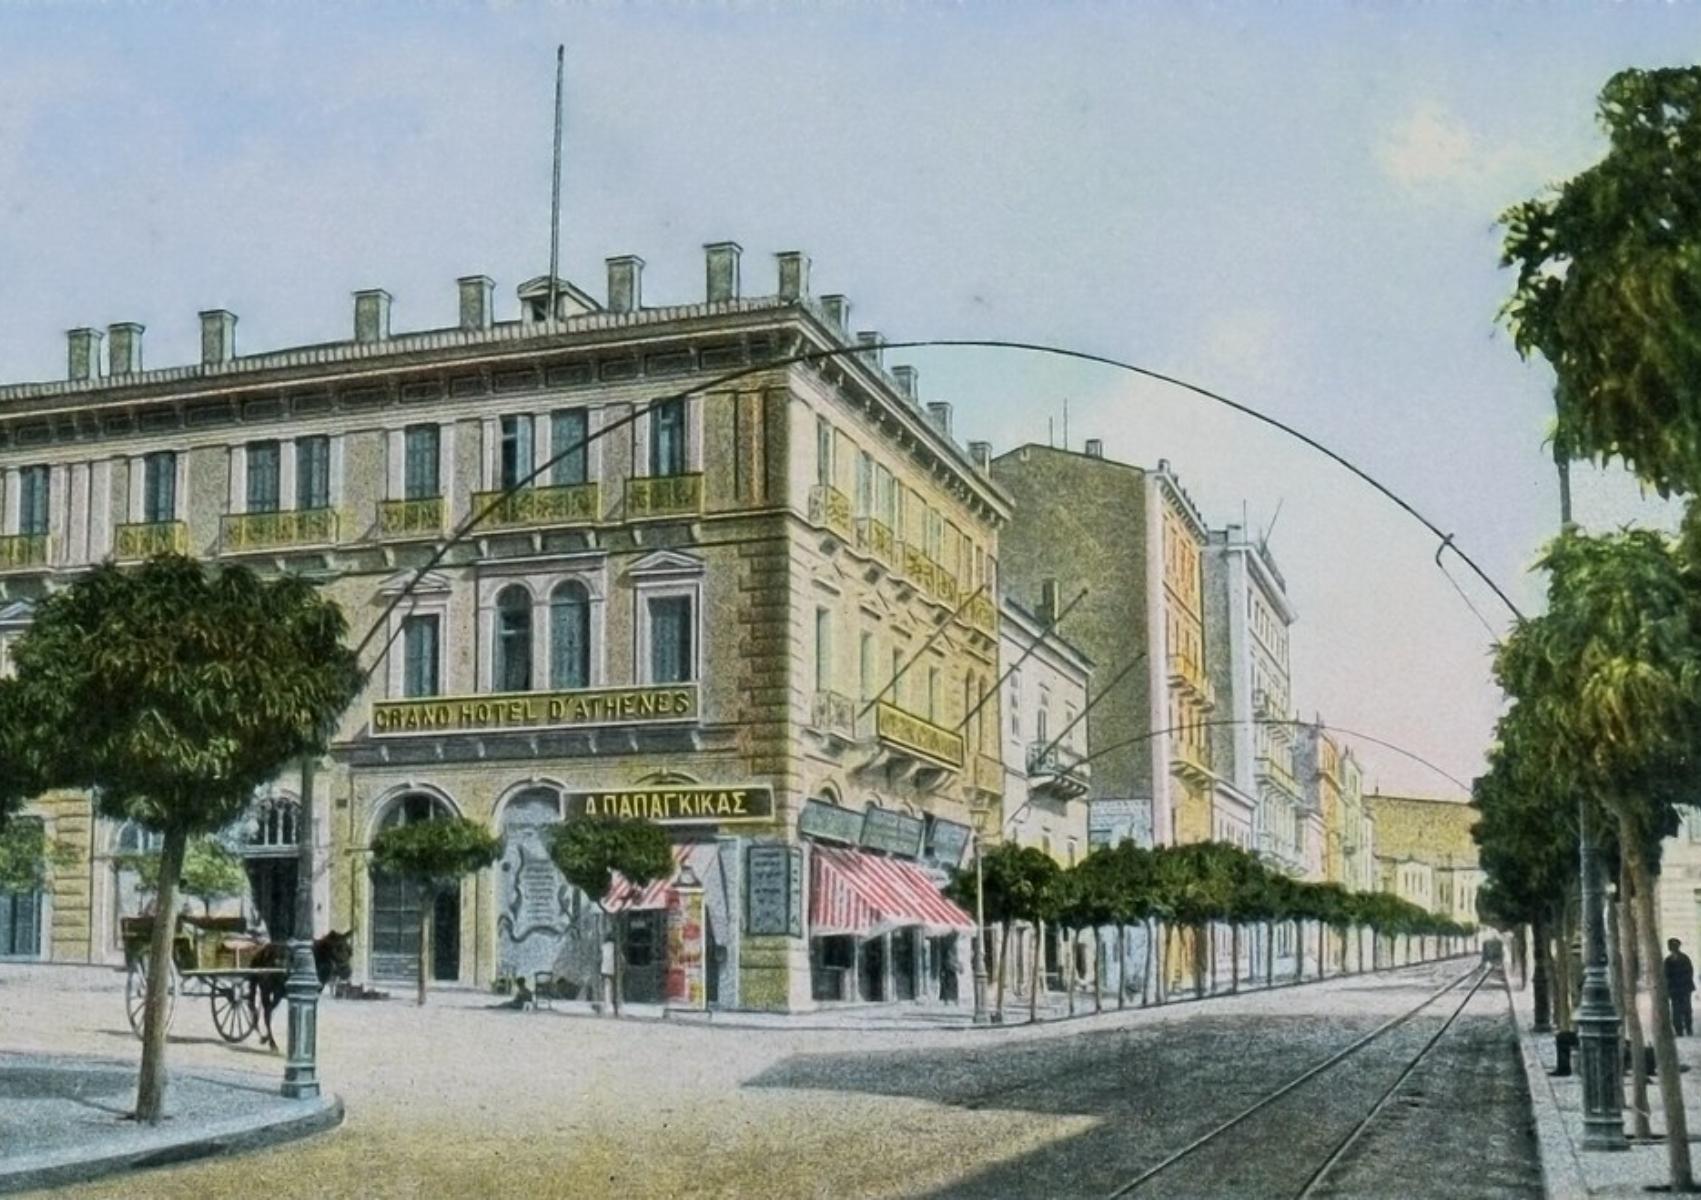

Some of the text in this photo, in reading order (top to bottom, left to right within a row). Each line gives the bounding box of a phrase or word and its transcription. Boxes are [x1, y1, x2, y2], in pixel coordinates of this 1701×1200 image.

[374, 690, 691, 731] GRAND HOTEL D'ATHENES
[603, 791, 747, 818] ΠΑΠΑΓΚΙΚΑΣ
